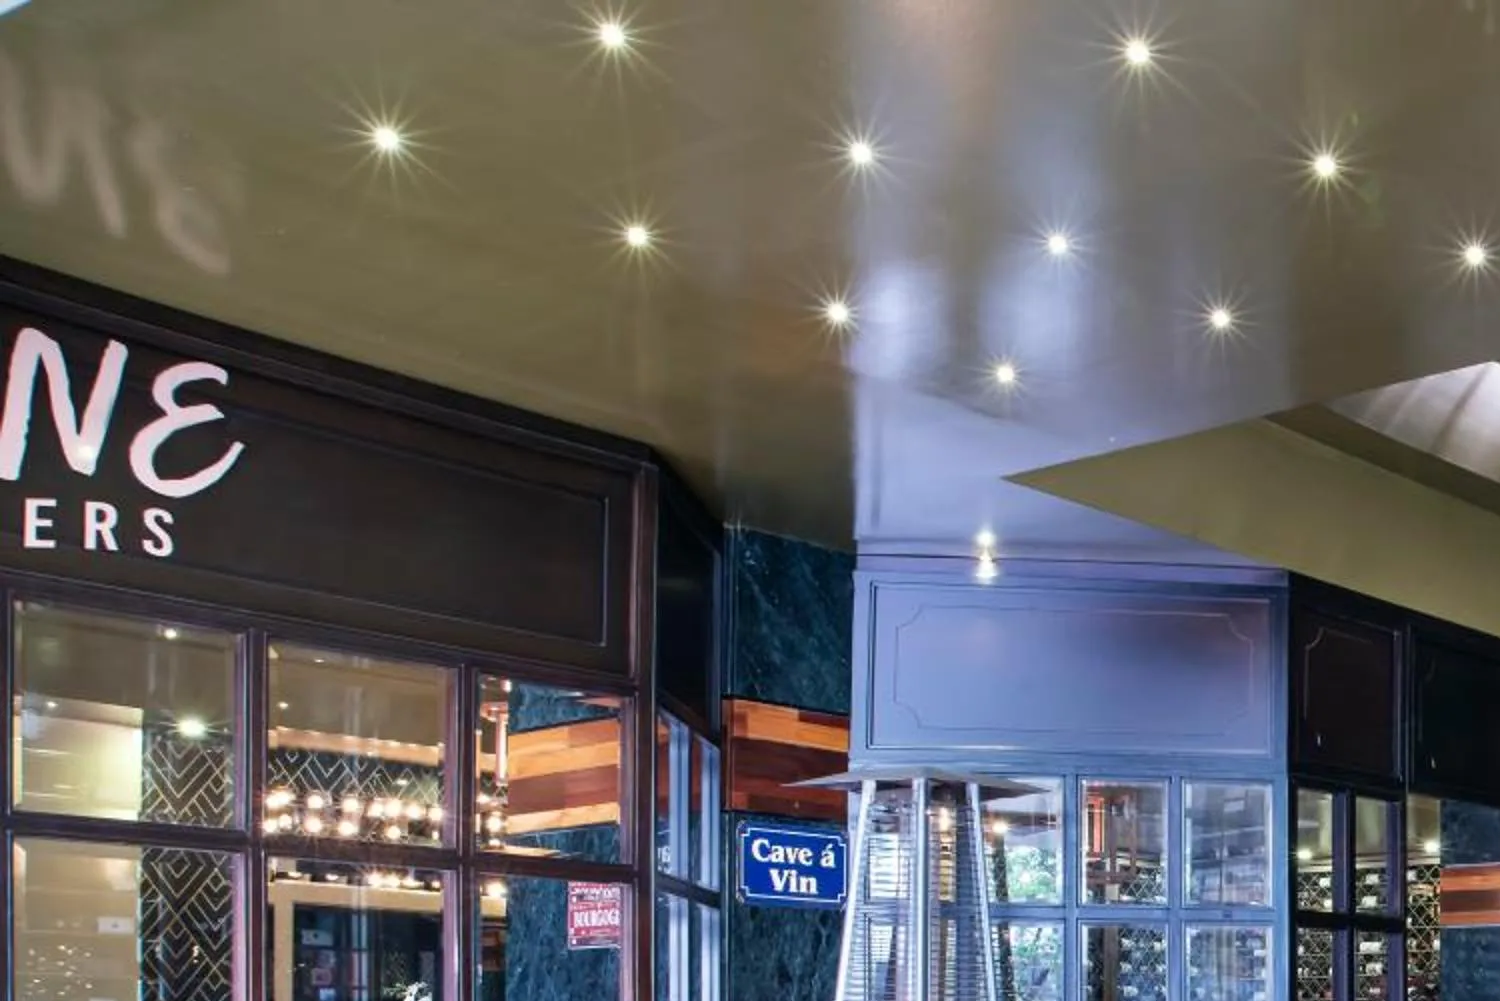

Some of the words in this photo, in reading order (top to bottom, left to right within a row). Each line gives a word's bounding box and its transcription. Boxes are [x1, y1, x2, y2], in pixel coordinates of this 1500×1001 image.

[0, 327, 245, 498] NE
[23, 498, 174, 557] ERS
[751, 838, 813, 866] Cave
[769, 868, 818, 894] Vin
